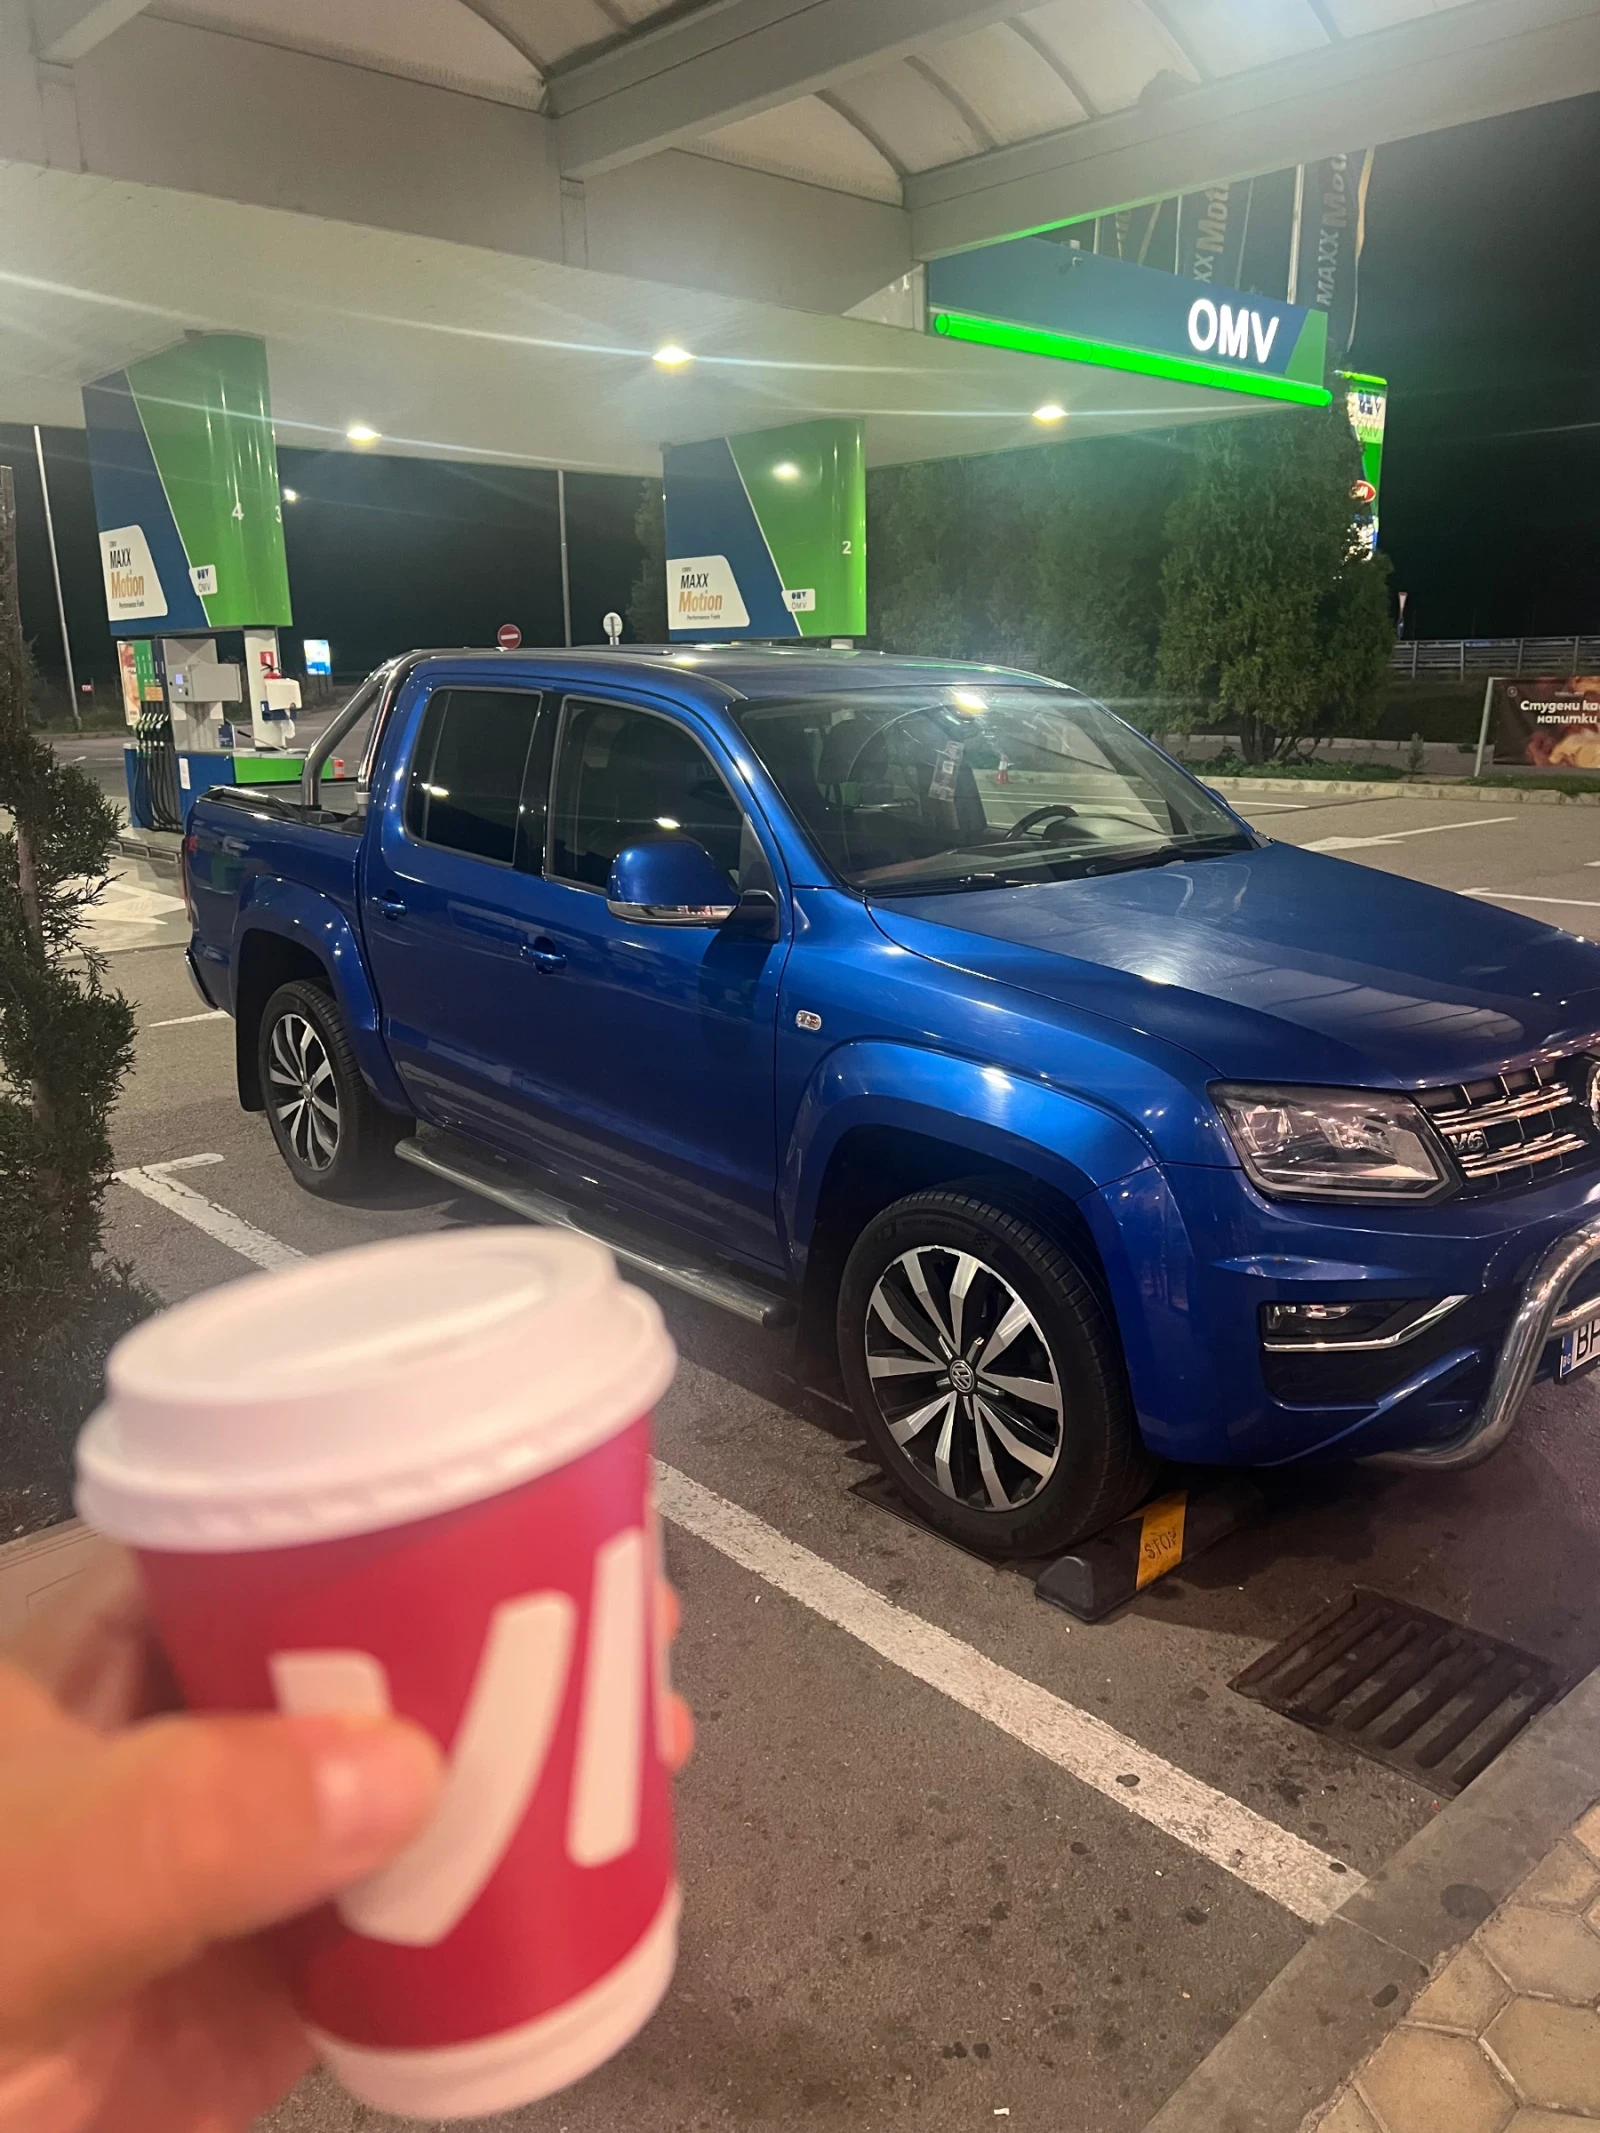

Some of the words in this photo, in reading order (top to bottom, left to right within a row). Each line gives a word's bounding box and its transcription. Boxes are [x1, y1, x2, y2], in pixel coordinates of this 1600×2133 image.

[1317, 229, 1340, 307] MAXX
[1187, 298, 1280, 364] OMV
[231, 502, 245, 521] 4
[275, 505, 282, 523] 3
[842, 540, 852, 555] 2
[110, 548, 132, 569] MAXX
[111, 569, 145, 599] Motion
[680, 573, 710, 590] MAXX
[678, 590, 723, 613] Motion
[791, 602, 807, 610] OMV
[1582, 700, 1600, 711] ка
[1450, 1130, 1484, 1151] V6
[1144, 1527, 1177, 1559] STOP
